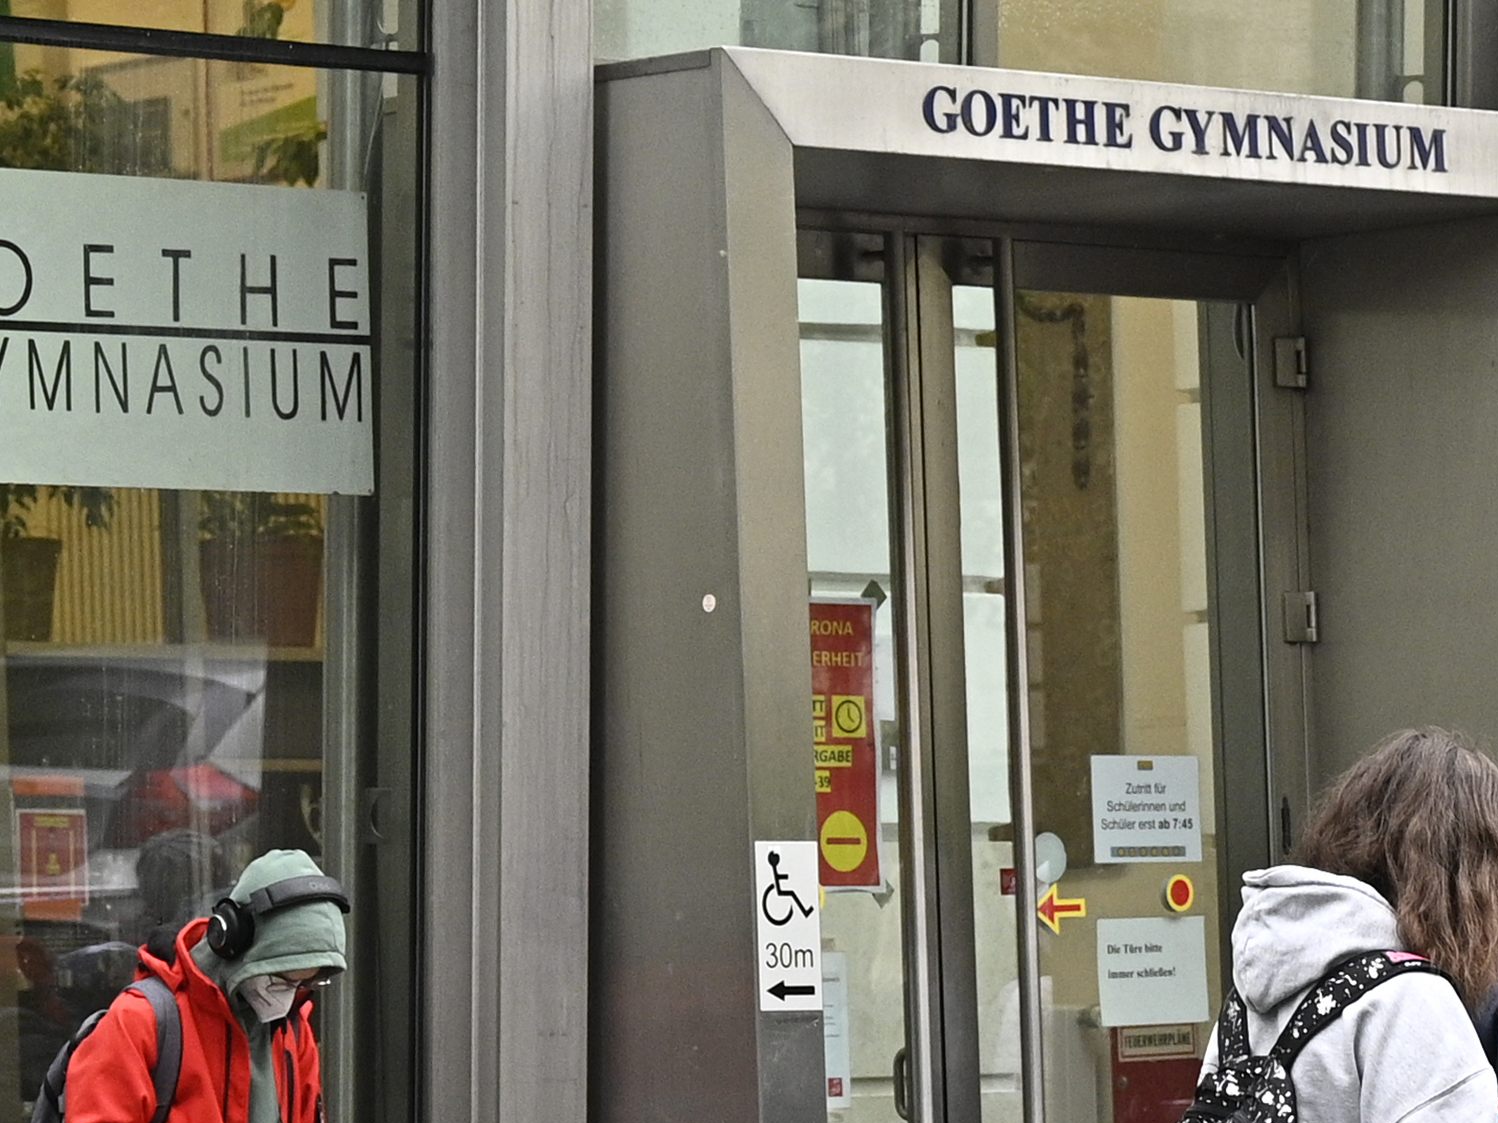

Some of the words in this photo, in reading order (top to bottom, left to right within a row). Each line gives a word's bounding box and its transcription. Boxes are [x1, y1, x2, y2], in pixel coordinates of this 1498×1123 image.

[922, 85, 1133, 149] GOETHE
[1149, 105, 1448, 173] GYMNASIUM
[0, 336, 363, 423] MNASIUM
[810, 620, 853, 635] RONA
[812, 650, 864, 667] ERHEIT
[1125, 782, 1152, 794] Zutritt
[1154, 782, 1166, 794] für
[1106, 800, 1166, 812] Schülerinnen
[1168, 801, 1186, 812] und
[1101, 818, 1136, 830] Schüler
[1138, 819, 1156, 830] erst
[1158, 818, 1170, 830] ab
[1172, 818, 1193, 830] 7:45
[1107, 944, 1120, 954] Die
[1122, 943, 1142, 954] Türe
[1144, 942, 1163, 953] bitte
[766, 942, 814, 969] 30m
[1108, 969, 1134, 979] immer
